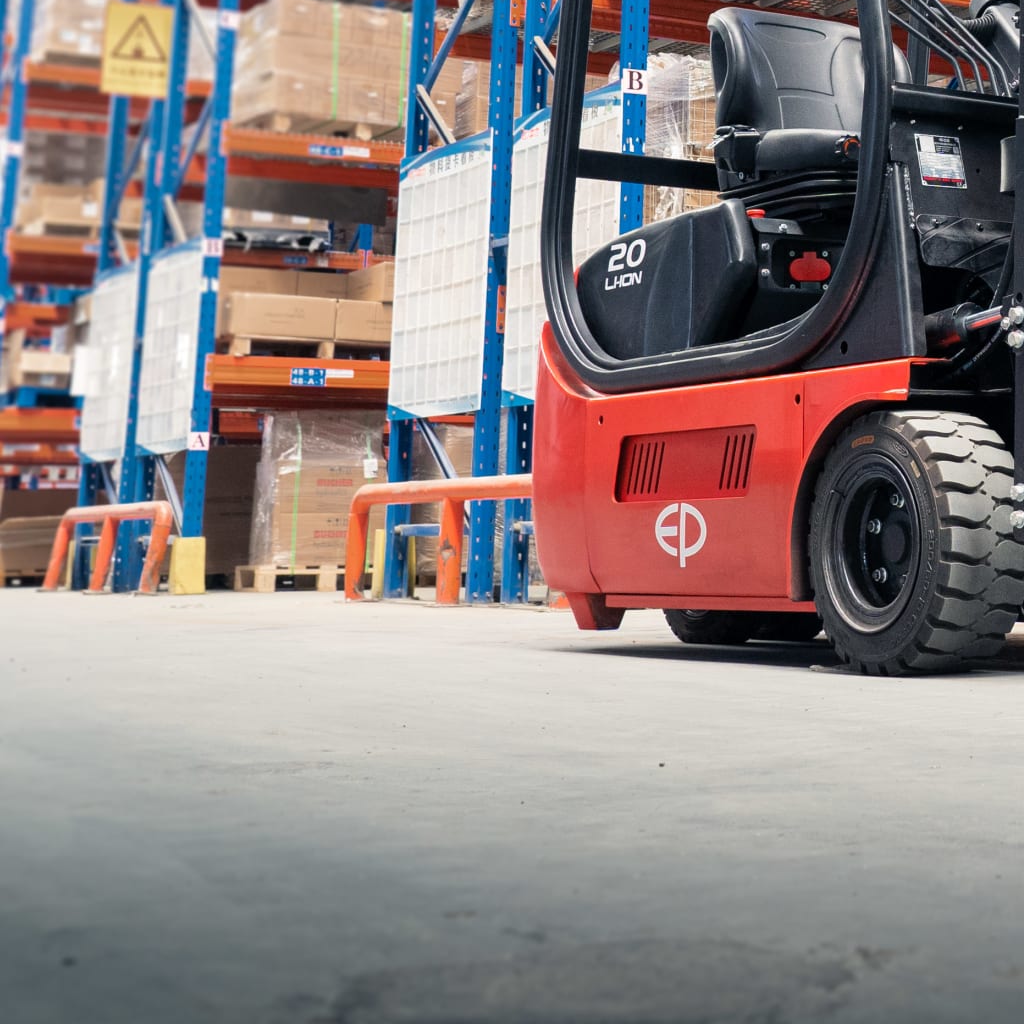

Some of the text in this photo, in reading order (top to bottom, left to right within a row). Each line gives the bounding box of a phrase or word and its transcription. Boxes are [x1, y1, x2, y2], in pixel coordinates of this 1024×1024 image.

[626, 70, 644, 91] B
[608, 238, 647, 272] 20
[192, 434, 205, 448] A
